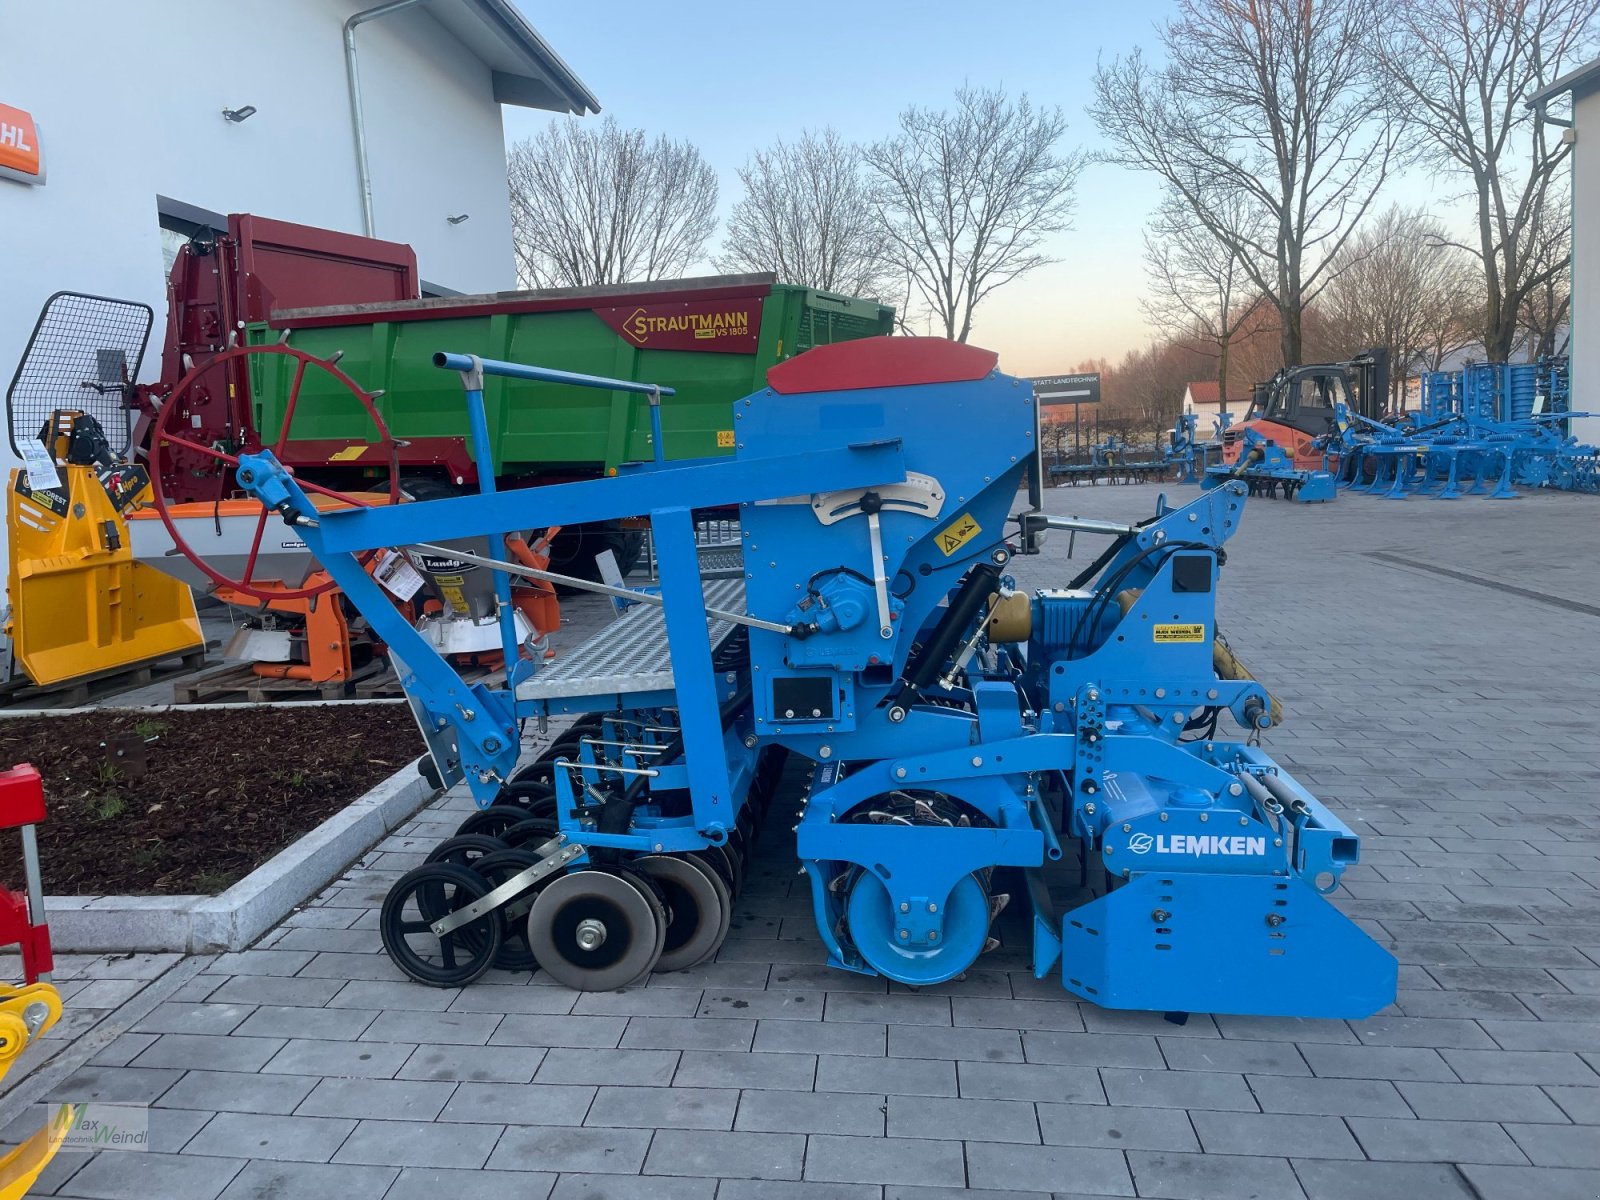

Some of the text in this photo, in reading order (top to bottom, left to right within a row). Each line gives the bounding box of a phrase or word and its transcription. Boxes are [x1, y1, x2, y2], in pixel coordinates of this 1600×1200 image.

[635, 311, 748, 335] STRAUTMANN
[717, 328, 728, 337] VS
[729, 326, 748, 336] 1805
[1156, 834, 1265, 859] LEMKEN
